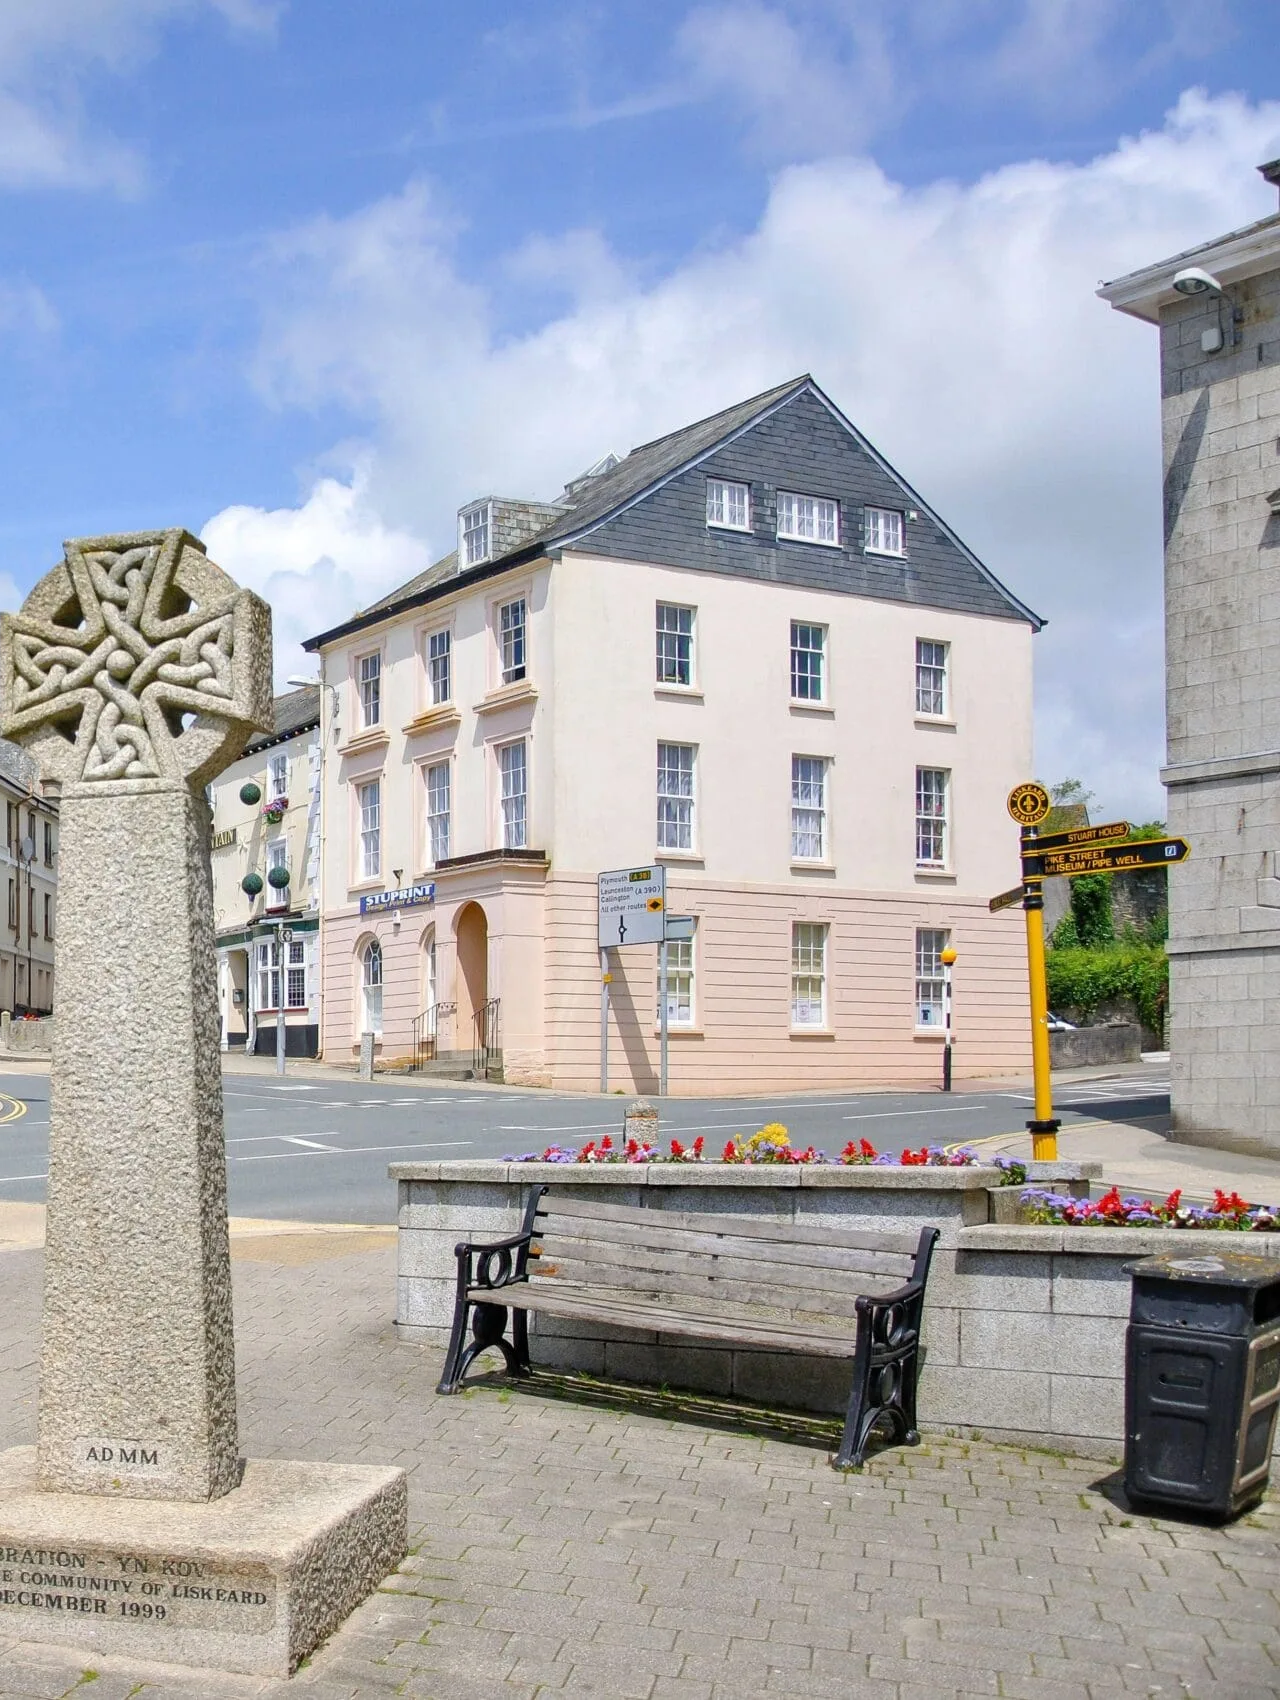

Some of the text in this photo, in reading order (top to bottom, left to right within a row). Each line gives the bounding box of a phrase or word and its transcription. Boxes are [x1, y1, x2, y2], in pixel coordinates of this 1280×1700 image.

[1012, 786, 1046, 800] LISKEARD
[1012, 807, 1046, 821] HERITAGE
[1068, 825, 1125, 843] STUART HOUSE
[1045, 850, 1105, 865] PIKE STREET
[1116, 855, 1143, 864] WELL
[365, 885, 432, 906] STUPRINT
[117, 1556, 149, 1573] YN
[20, 1572, 134, 1593] COMMUNITY
[141, 1581, 165, 1596] OF
[172, 1584, 267, 1606] LISKEARD
[120, 1601, 166, 1619] 1999
